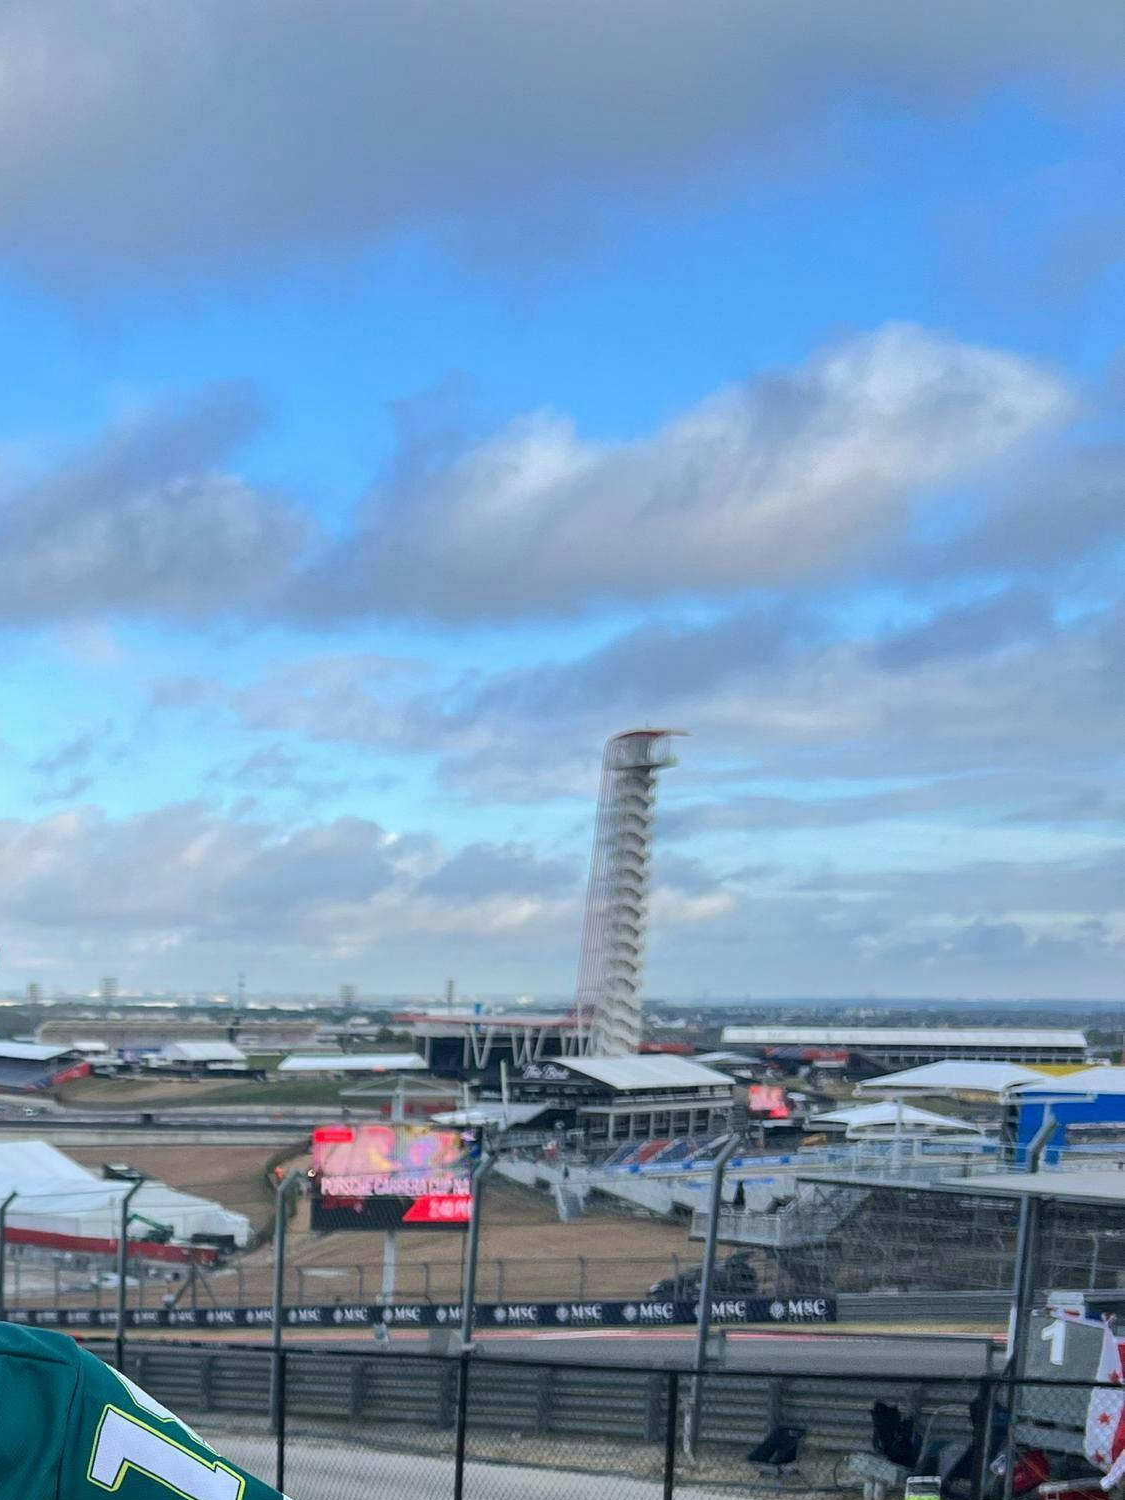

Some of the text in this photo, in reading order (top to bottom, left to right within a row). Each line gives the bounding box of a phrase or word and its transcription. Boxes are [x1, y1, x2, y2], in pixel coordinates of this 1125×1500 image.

[343, 1309, 367, 1321] MSC
[394, 1308, 420, 1320] MSC
[508, 1305, 538, 1320] MSC
[571, 1304, 602, 1318] MSC
[640, 1302, 674, 1318] MSC
[711, 1300, 746, 1317] MSC
[788, 1299, 826, 1316] MSC
[1041, 1320, 1066, 1366] 1
